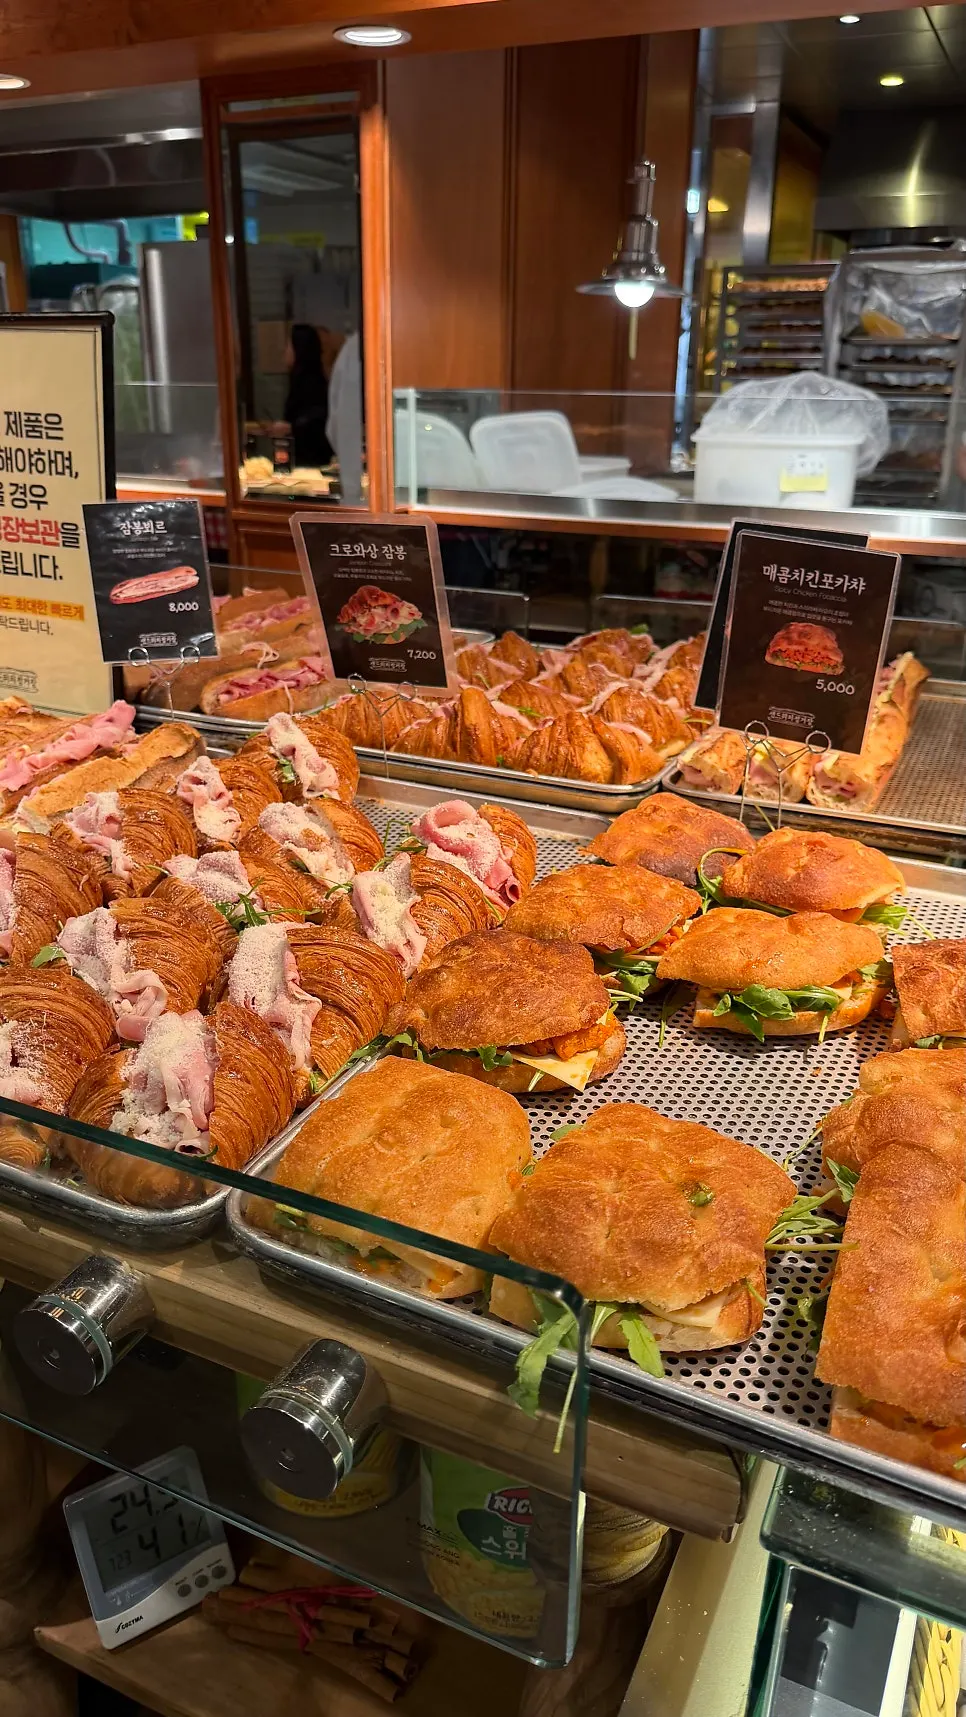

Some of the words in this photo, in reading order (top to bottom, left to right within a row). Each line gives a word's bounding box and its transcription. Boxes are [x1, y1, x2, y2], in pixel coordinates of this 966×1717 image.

[4, 411, 64, 441] 제품은
[9, 482, 48, 511] 경우
[0, 516, 80, 549] 장보관을
[119, 519, 168, 536] 잠봉뵈르
[329, 542, 379, 559] 크로와상
[381, 544, 407, 561] 잠봉
[0, 551, 63, 581] 립니다.
[762, 563, 866, 596] 매콤치킨포카챠
[168, 602, 199, 614] 8,000
[407, 649, 436, 660] 7,200
[815, 679, 855, 695] 5,000
[493, 1495, 533, 1514] RIC
